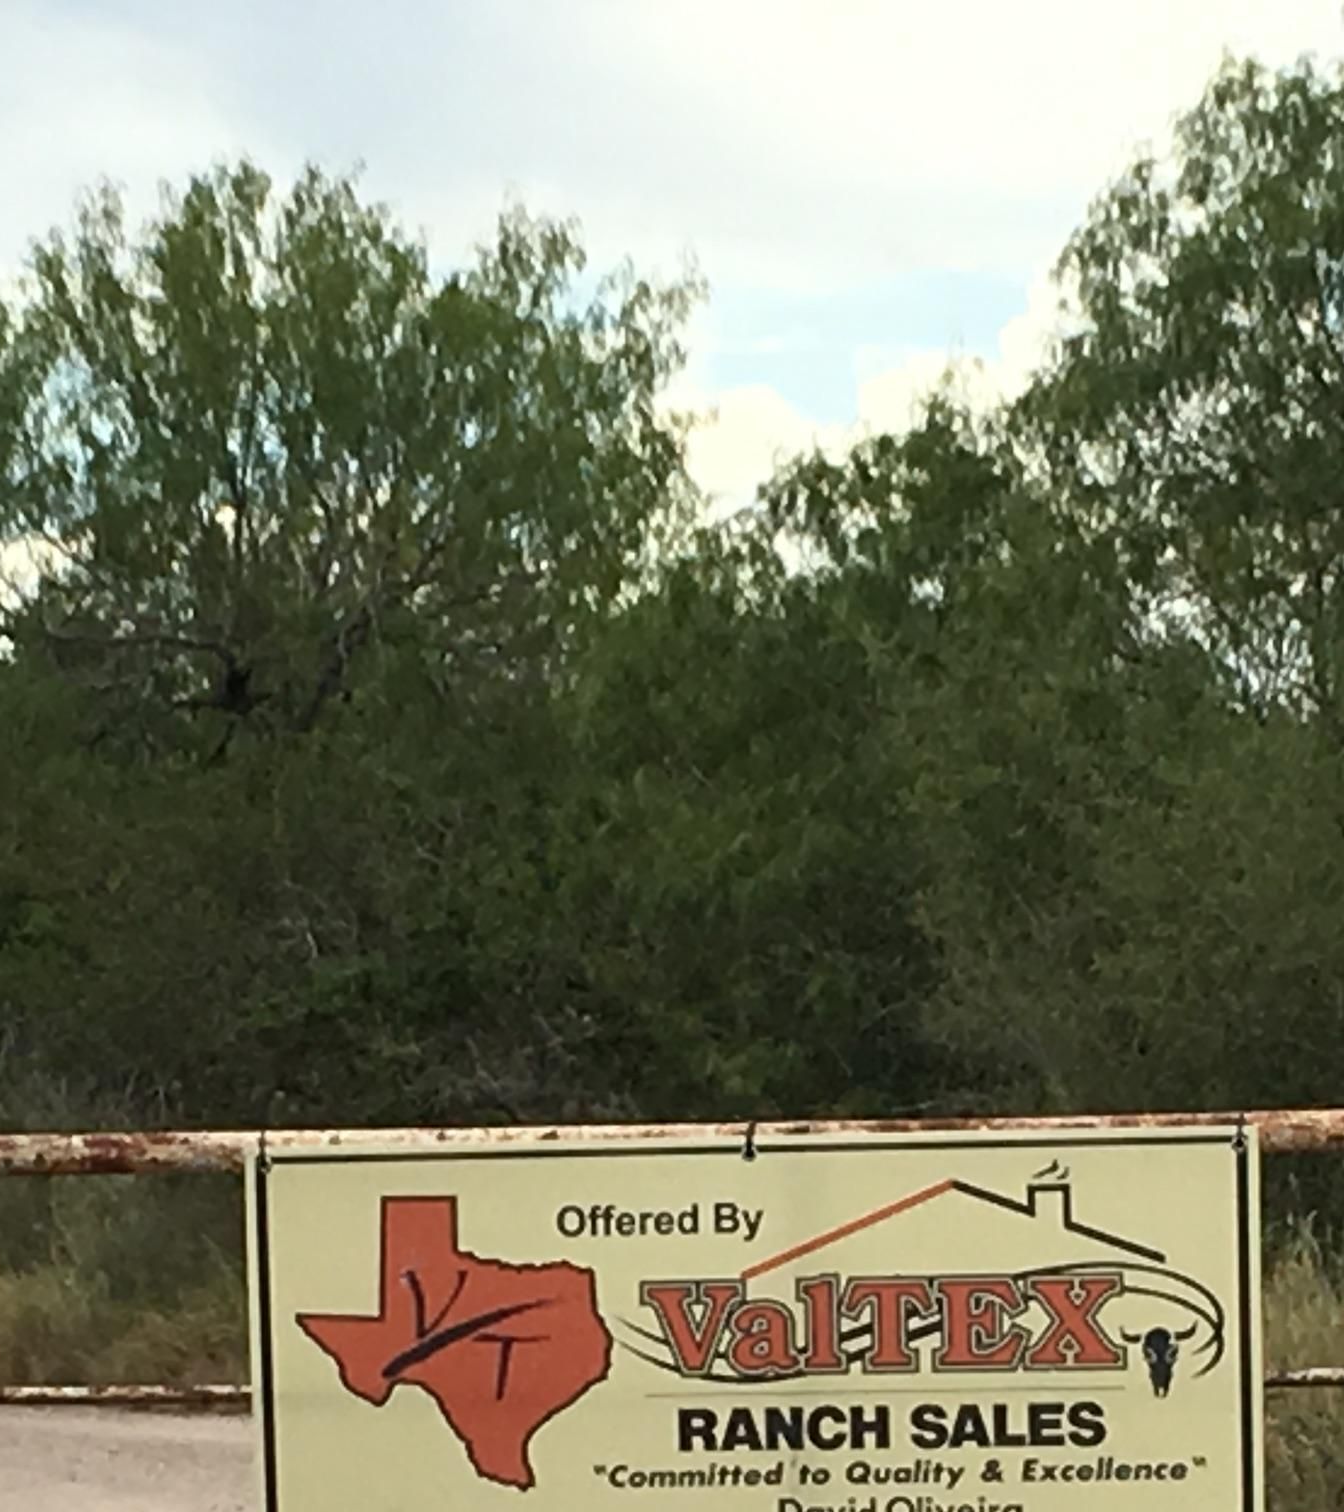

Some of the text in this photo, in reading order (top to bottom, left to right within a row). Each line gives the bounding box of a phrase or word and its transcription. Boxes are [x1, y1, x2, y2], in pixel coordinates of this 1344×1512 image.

[556, 1202, 763, 1241] Offered By
[640, 1273, 1127, 1377] ValTEX
[677, 1401, 1107, 1451] RANCH SALES
[799, 1464, 831, 1486] to
[845, 1459, 965, 1490] Quality
[980, 1459, 1004, 1483] &
